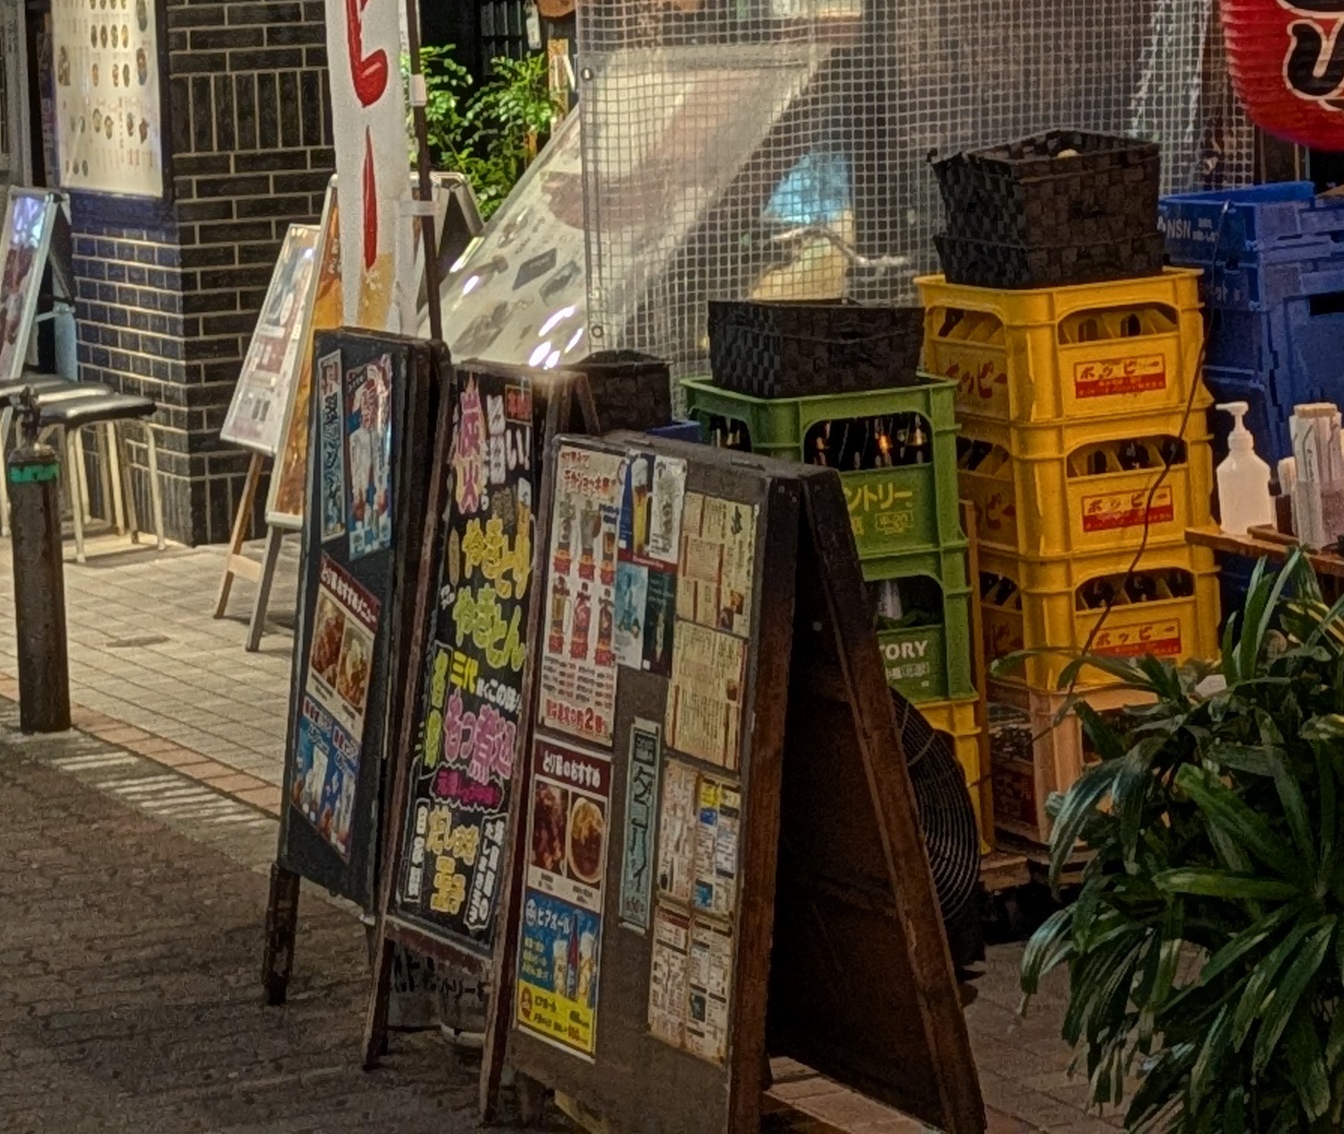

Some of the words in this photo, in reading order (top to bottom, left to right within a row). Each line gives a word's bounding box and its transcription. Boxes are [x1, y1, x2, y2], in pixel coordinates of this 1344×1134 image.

[1079, 360, 1161, 380] ホッピー
[843, 481, 913, 512] ントリー
[462, 514, 532, 601] やきとり
